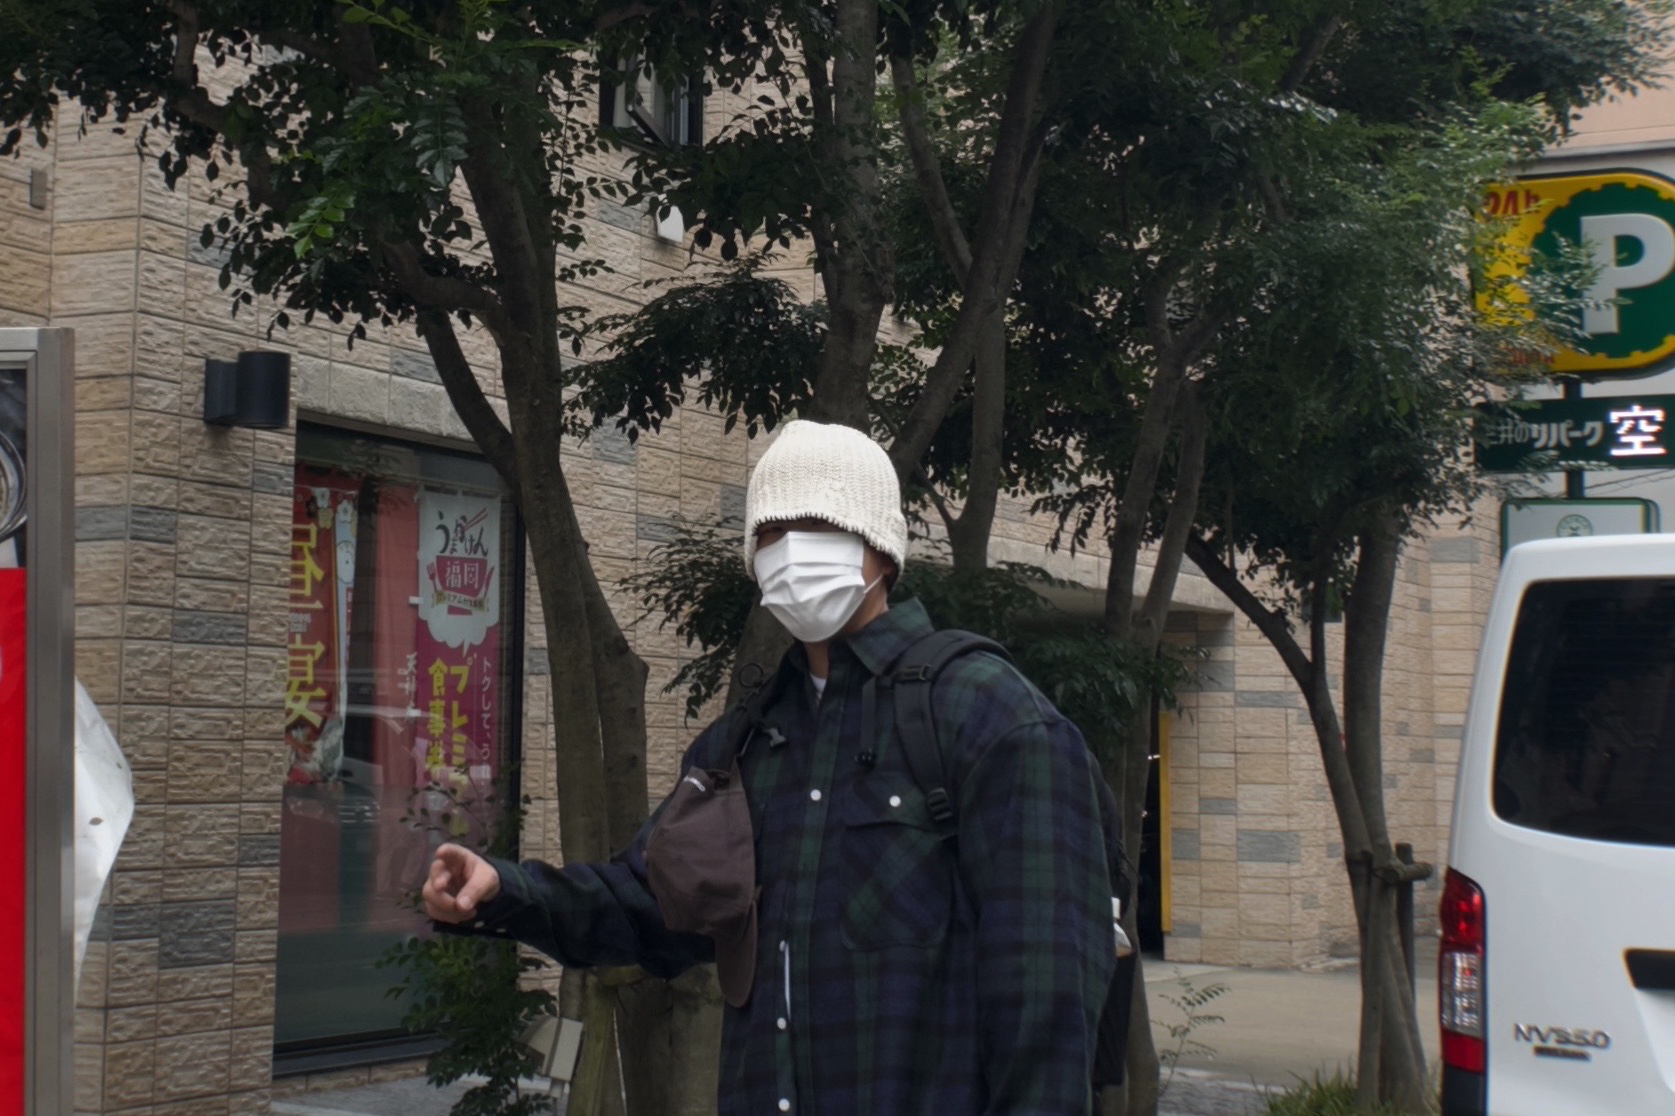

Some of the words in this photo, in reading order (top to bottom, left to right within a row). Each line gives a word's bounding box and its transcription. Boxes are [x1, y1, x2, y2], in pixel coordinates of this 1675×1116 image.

[1580, 213, 1675, 334] P
[1609, 405, 1667, 457] 空
[444, 560, 480, 590] 福岡
